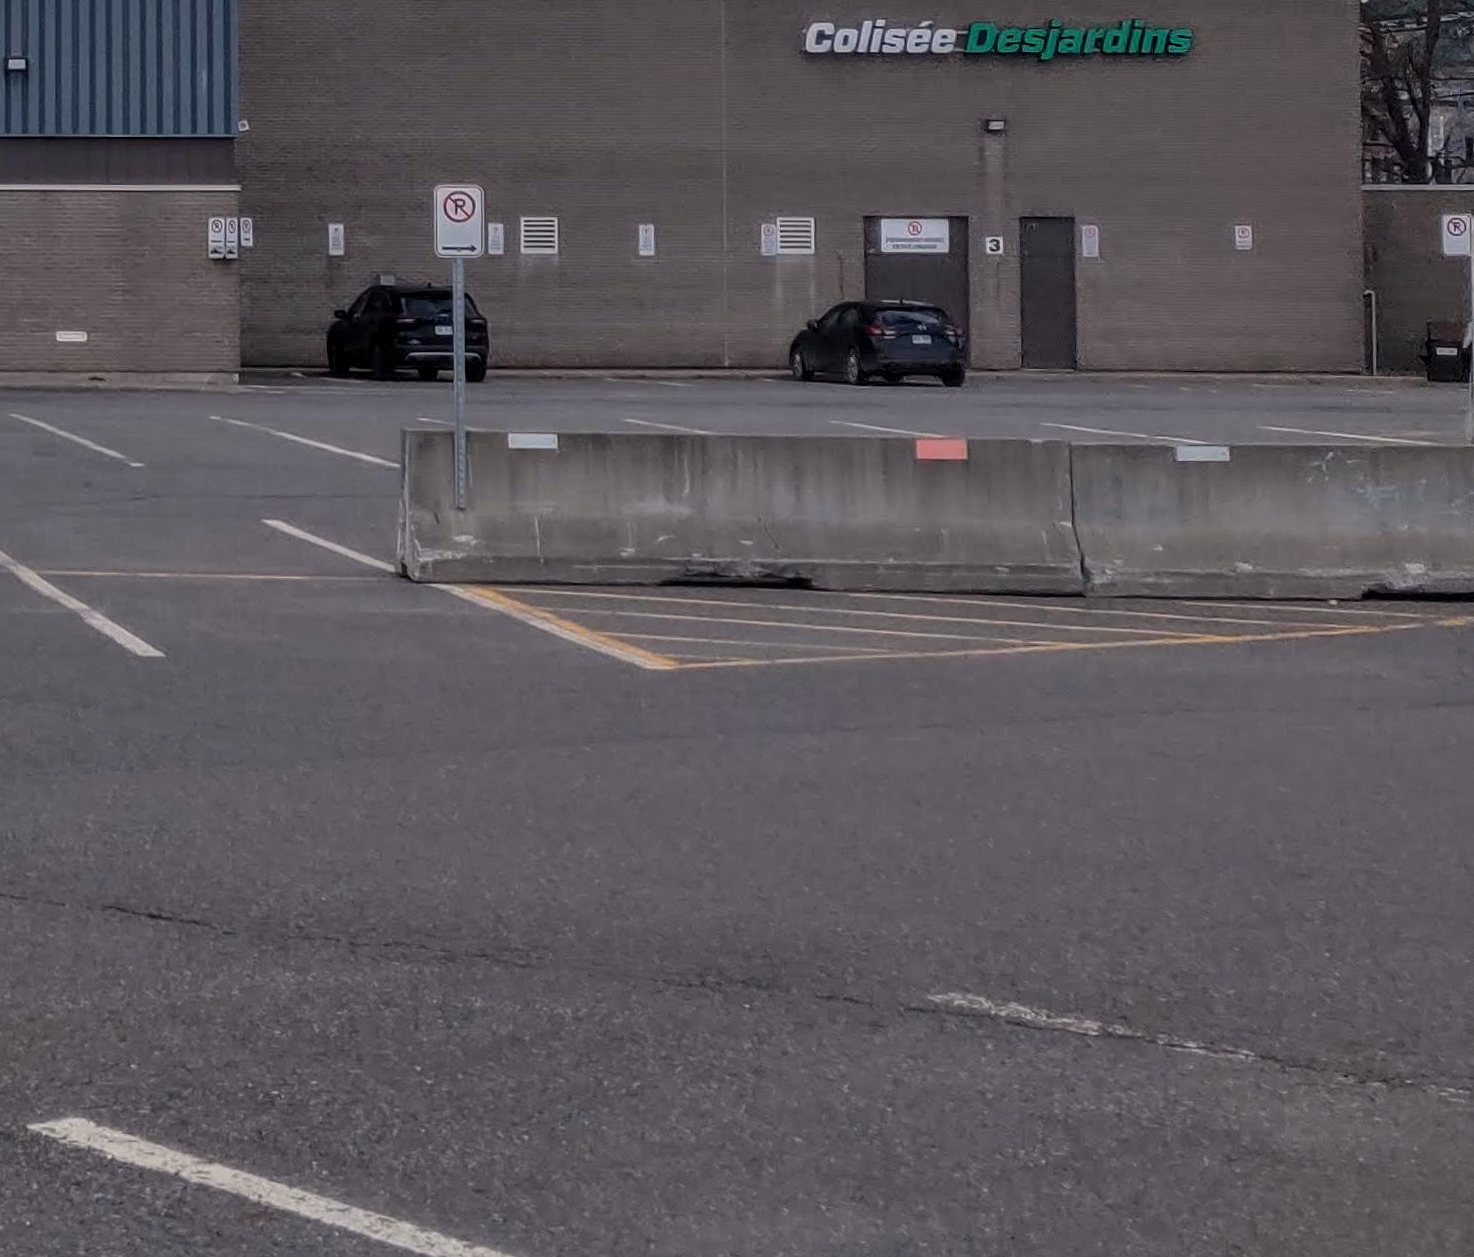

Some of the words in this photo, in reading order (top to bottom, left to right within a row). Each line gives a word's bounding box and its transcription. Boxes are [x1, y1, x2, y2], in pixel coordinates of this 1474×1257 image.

[804, 19, 957, 54] Colisée
[965, 19, 1194, 61] Desjardins
[988, 238, 1002, 252] 3
